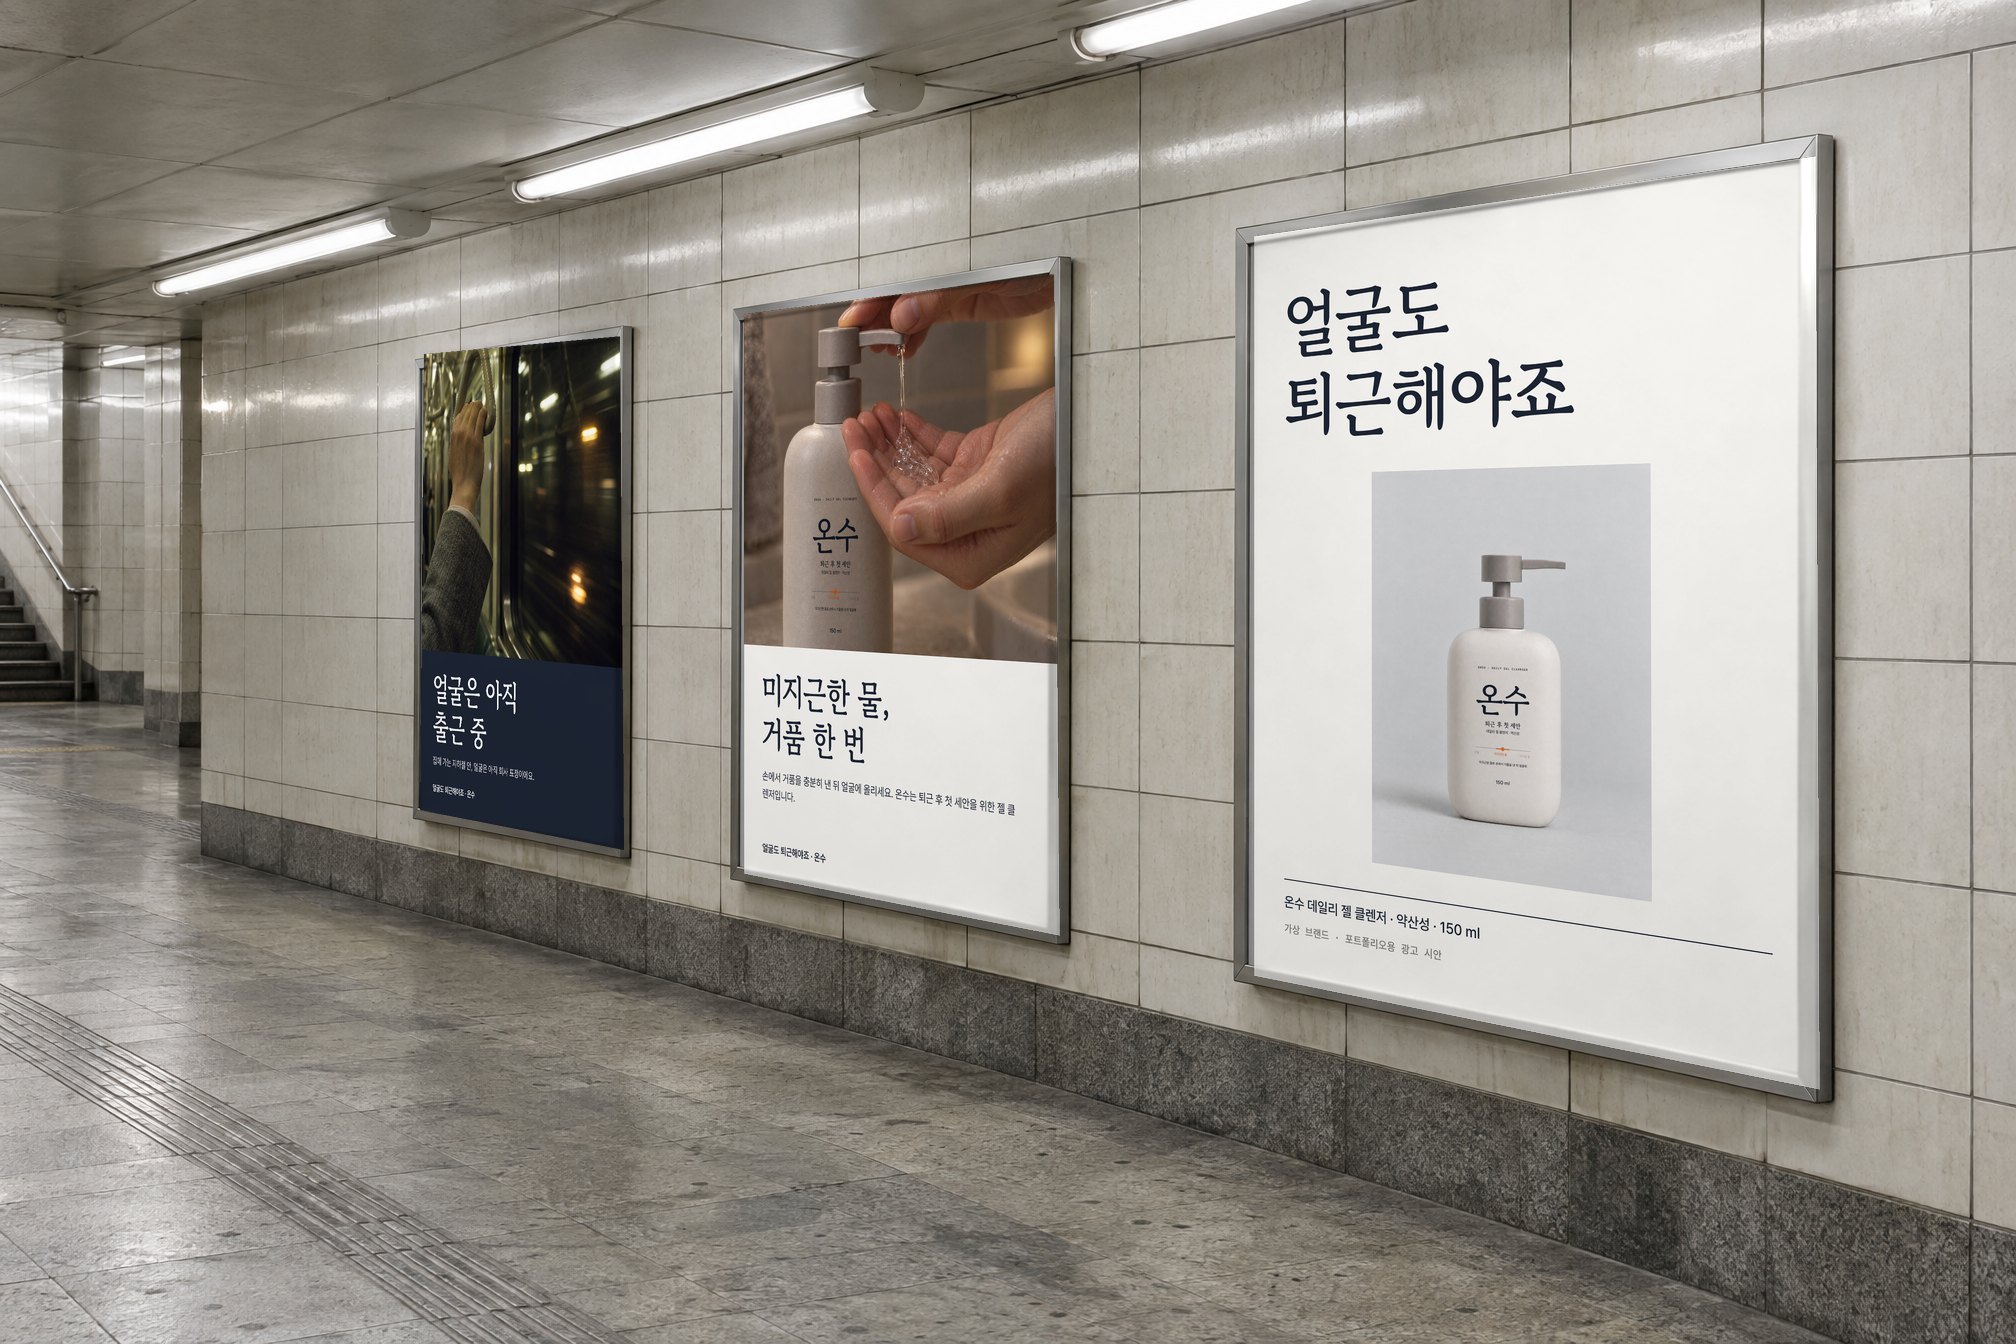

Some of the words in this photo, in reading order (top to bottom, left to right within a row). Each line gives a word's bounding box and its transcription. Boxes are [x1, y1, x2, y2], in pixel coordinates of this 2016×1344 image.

[1286, 281, 1449, 357] 얼굴도
[1285, 357, 1574, 436] 퇴근해야죠
[813, 518, 858, 553] 온수
[433, 674, 480, 709] 얼굴은
[486, 679, 518, 715] 아직
[762, 673, 850, 716] 미지근한
[857, 682, 889, 721] 물,
[1476, 684, 1530, 716] 온수
[433, 711, 465, 746] 출근
[470, 717, 487, 750] 중
[762, 718, 805, 757] 거품
[812, 722, 836, 760] 한
[843, 726, 865, 764] 번
[762, 771, 781, 783] 손에서
[782, 774, 802, 786] 거품을
[803, 776, 823, 789] 충분히
[825, 779, 832, 790] 낸
[833, 780, 840, 792] 뒤
[841, 781, 862, 794] 얼굴에
[863, 784, 893, 798] 올리세요.
[895, 788, 917, 802] 온수는
[918, 792, 934, 804] 퇴근
[935, 794, 943, 805] 후
[944, 795, 953, 807] 첫
[955, 797, 977, 811] 세안을
[979, 800, 995, 813] 위한
[997, 802, 1005, 814] 젤
[1007, 803, 1016, 816] 클
[762, 788, 796, 802] 렌저입니다.
[762, 843, 780, 857] 얼굴도
[780, 846, 810, 861] 퇴근해야죠
[814, 851, 826, 863] 온수
[1284, 895, 1304, 911] 온수
[1307, 900, 1338, 916] 데일리
[1341, 904, 1352, 919] 젤
[1355, 908, 1387, 925] 클렌저
[1396, 914, 1430, 932] 약산성
[1440, 921, 1462, 936] 150
[1465, 926, 1480, 939] ml
[1284, 923, 1300, 936] 가상
[1305, 927, 1330, 940] 브랜드
[1345, 934, 1396, 953] 포트폴리오용
[1400, 943, 1419, 956] 광고
[1424, 948, 1442, 961] 시안
